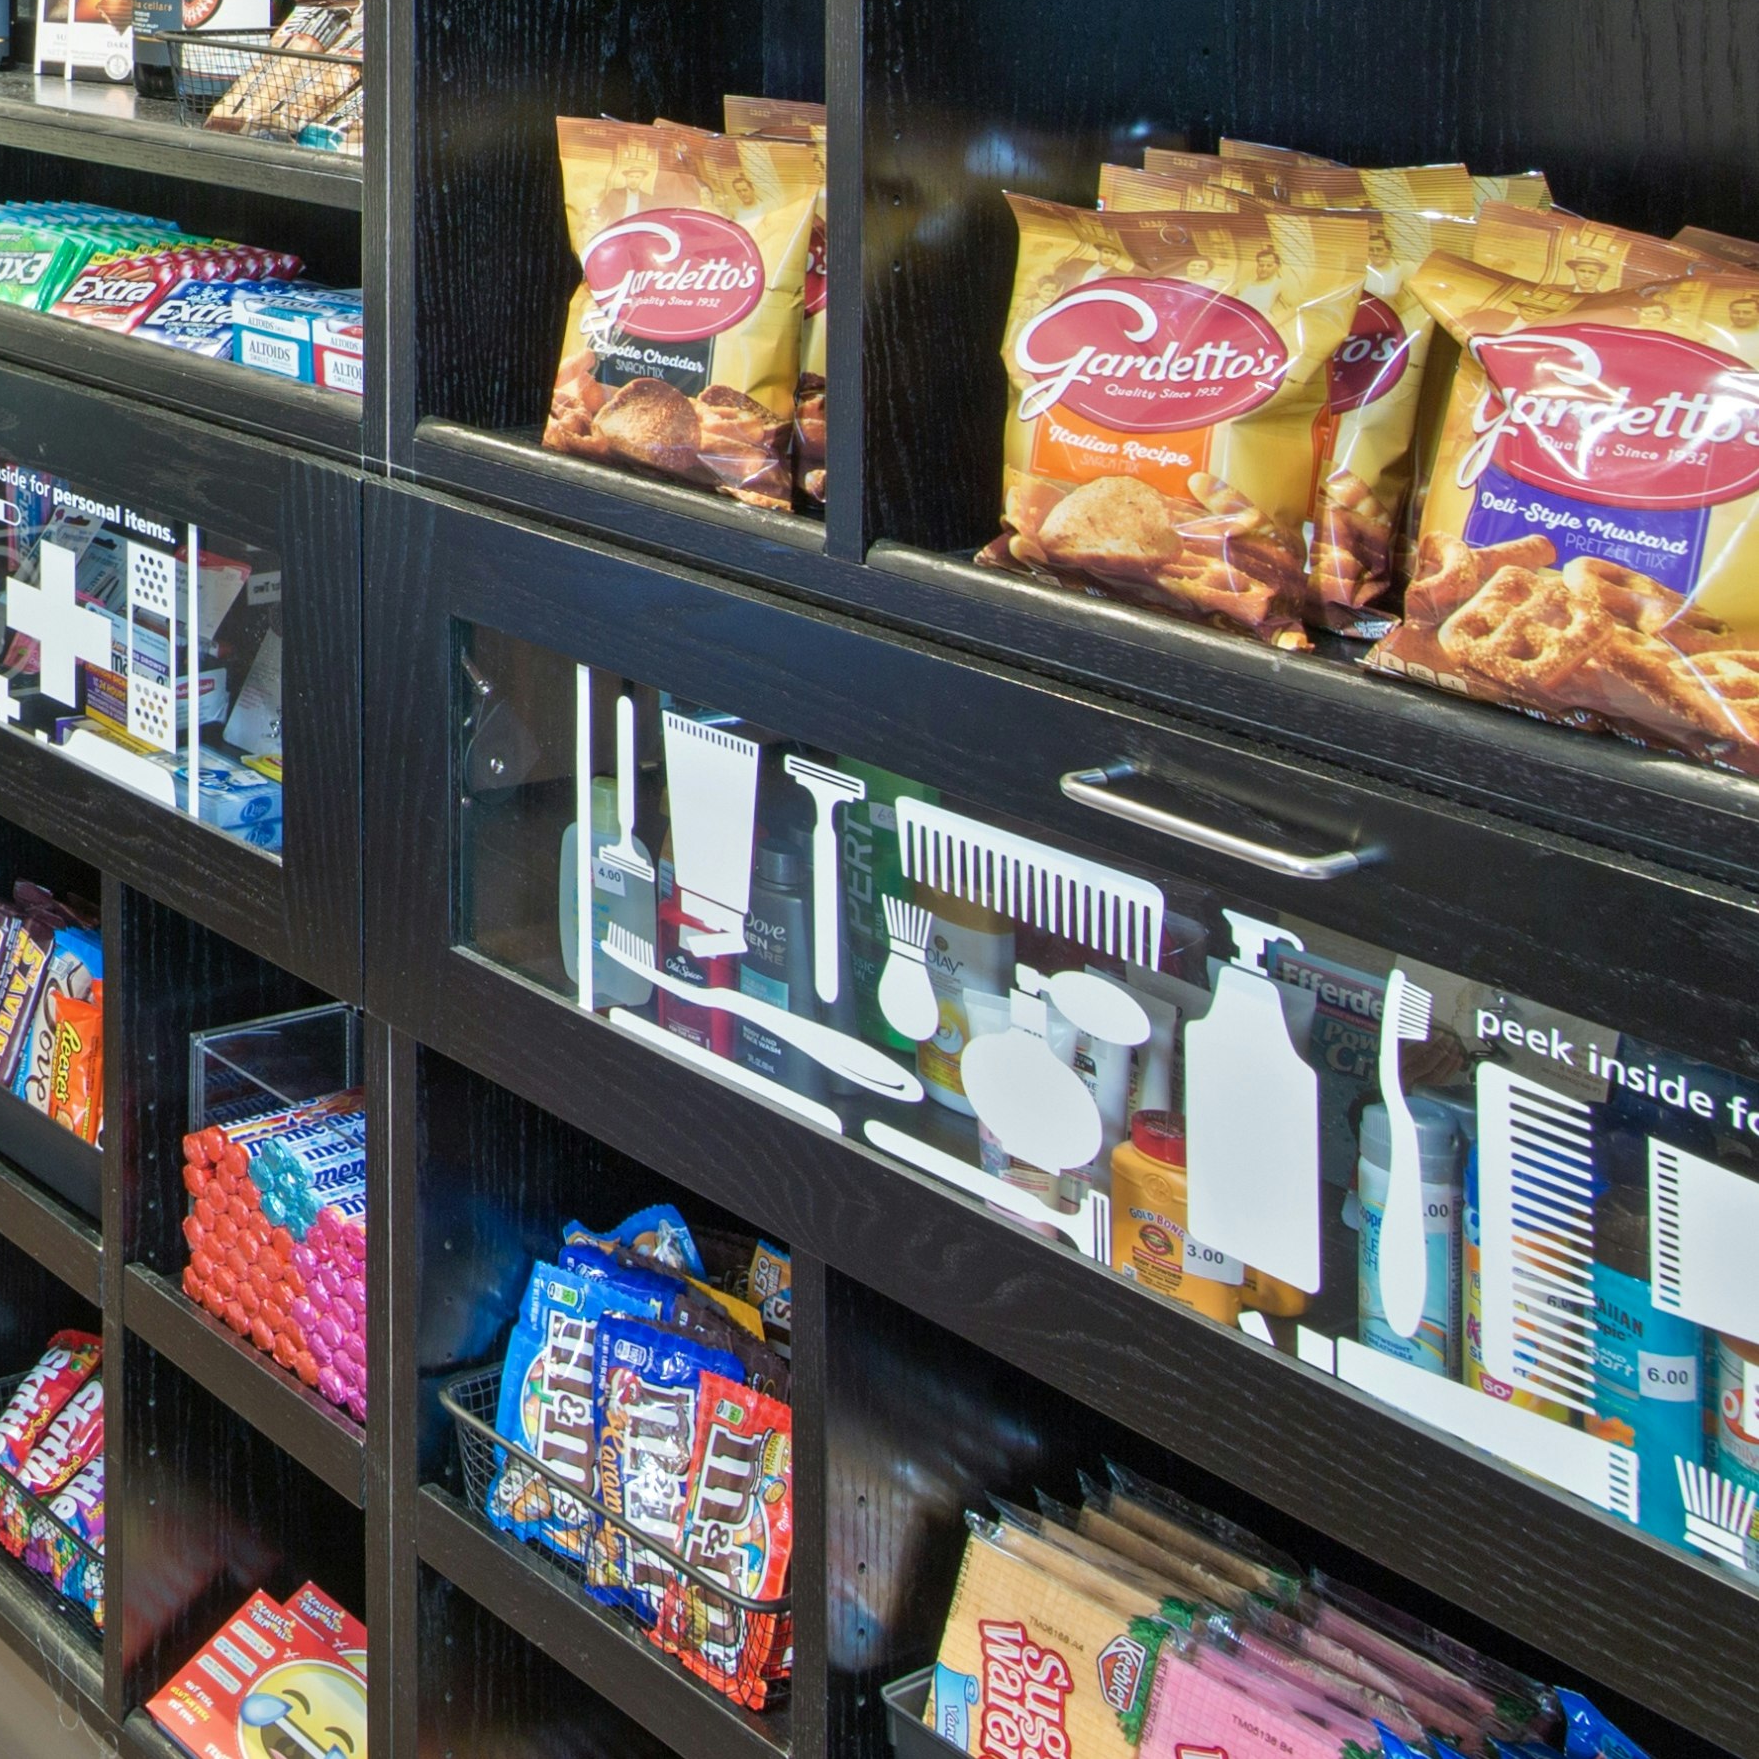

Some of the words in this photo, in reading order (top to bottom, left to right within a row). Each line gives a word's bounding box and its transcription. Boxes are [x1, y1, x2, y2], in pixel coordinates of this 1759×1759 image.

[143, 2, 172, 12] cellars
[63, 276, 158, 304] Extra
[579, 221, 758, 343] Gardetto's
[146, 299, 234, 326] Extra
[697, 296, 720, 308] 1932
[249, 340, 291, 363] ALTOIDS
[643, 347, 705, 374] Cheddar
[1016, 289, 1280, 422] Gardetto's
[1104, 381, 1156, 401] Quality
[1159, 386, 1191, 400] Since
[1195, 385, 1224, 399] 1932
[1047, 423, 1120, 453] Italian
[1122, 440, 1192, 470] Recipe
[1615, 443, 1660, 463] Since
[1666, 448, 1708, 466] 1932
[30, 477, 51, 497] for
[53, 486, 121, 525] personal
[124, 507, 176, 544] items.
[1480, 491, 1581, 534] Deli-Style
[1585, 516, 1690, 558] Mustard
[1565, 532, 1633, 564] PRETZEL
[597, 866, 622, 882] 4.00
[1282, 961, 1383, 1022] Efferde
[56, 1020, 81, 1104] Reese's
[1477, 1008, 1574, 1066] peek
[1588, 1043, 1715, 1118] inside
[1128, 1207, 1155, 1223] GOLD
[1186, 1243, 1225, 1265] 3.00
[1647, 1367, 1689, 1384] 6.00
[1108, 1637, 1144, 1712] Keebler
[983, 1623, 1023, 1759] Wafer
